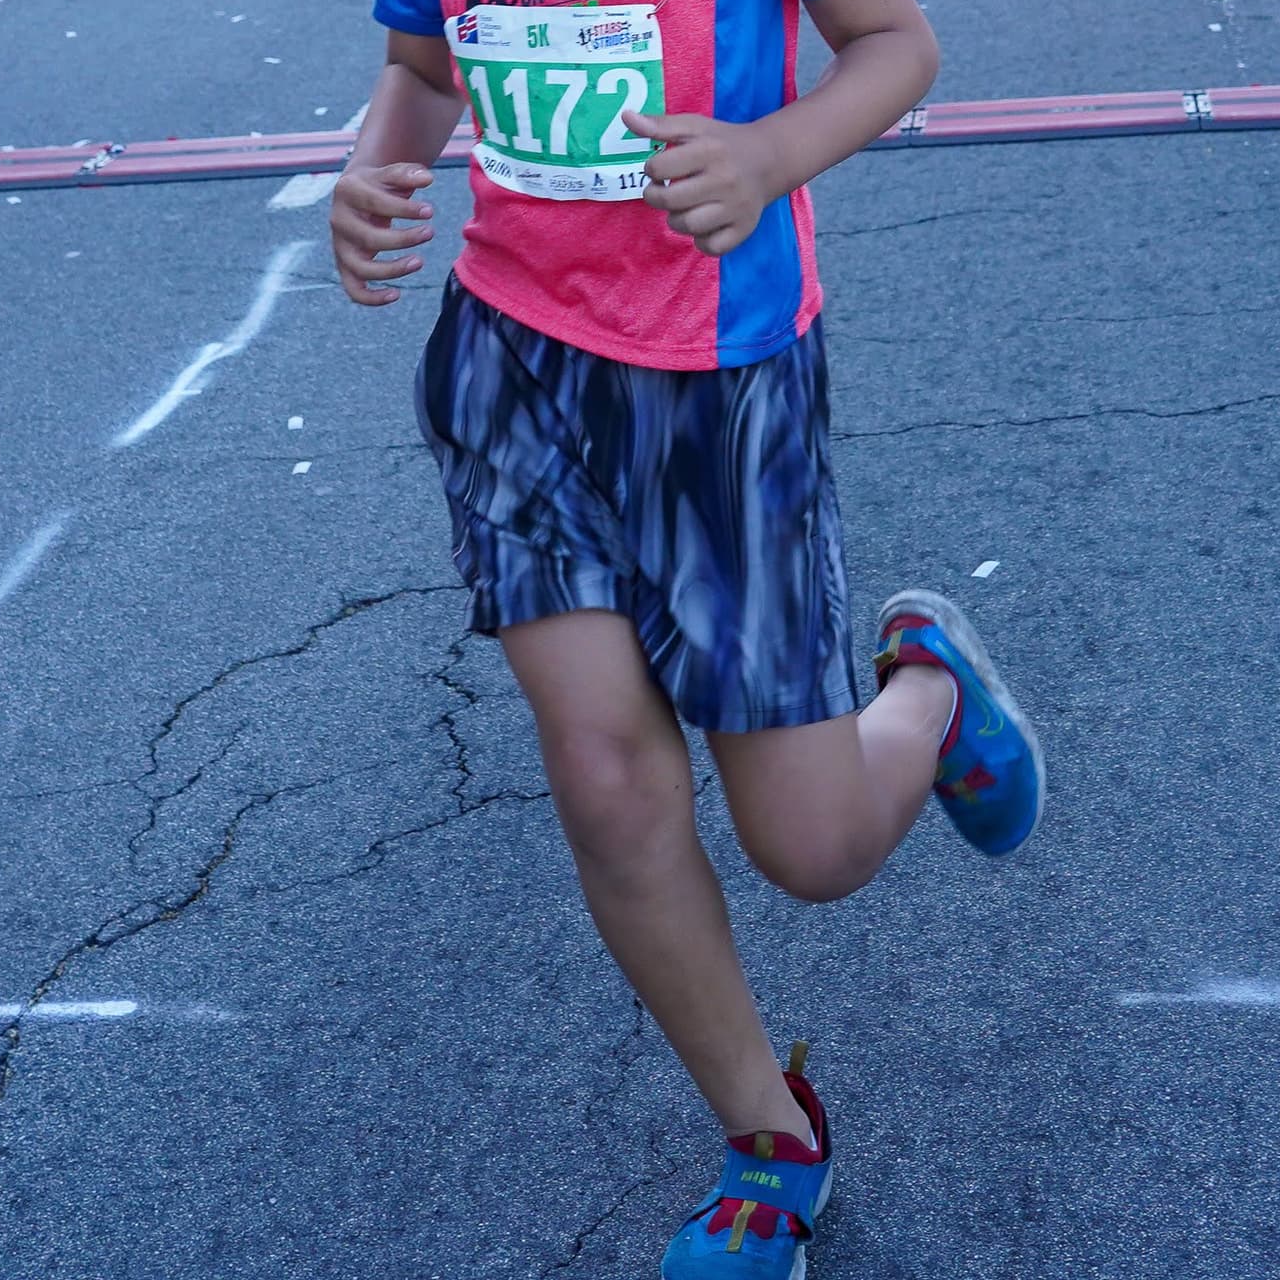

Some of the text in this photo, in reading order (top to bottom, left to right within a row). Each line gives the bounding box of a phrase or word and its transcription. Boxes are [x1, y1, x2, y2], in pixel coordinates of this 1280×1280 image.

[527, 23, 550, 48] 5K
[468, 65, 652, 156] 1172
[619, 172, 646, 190] 117
